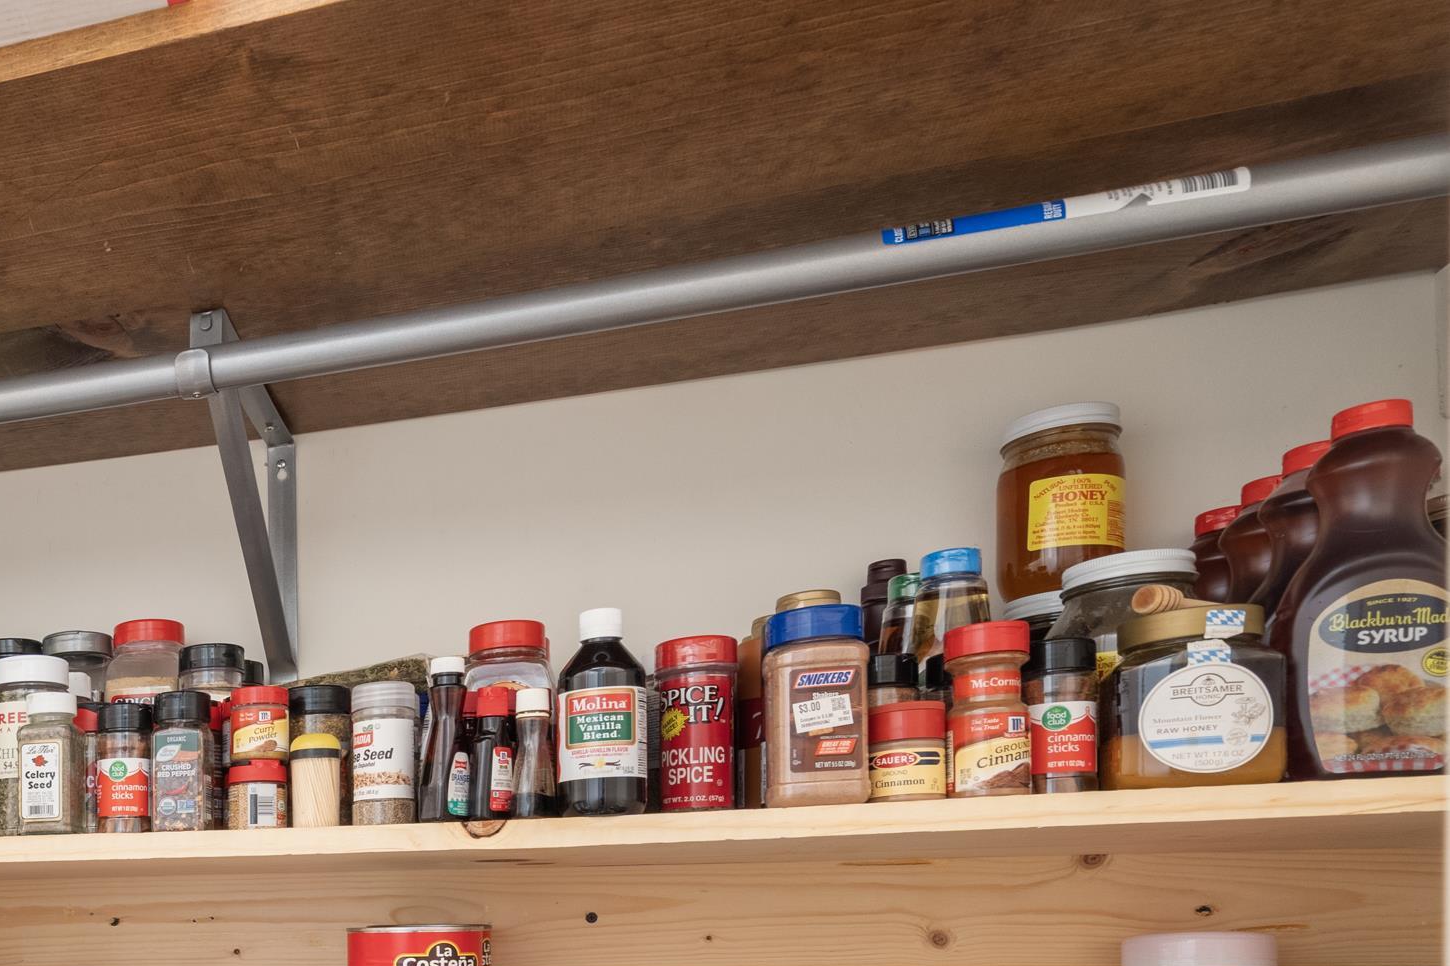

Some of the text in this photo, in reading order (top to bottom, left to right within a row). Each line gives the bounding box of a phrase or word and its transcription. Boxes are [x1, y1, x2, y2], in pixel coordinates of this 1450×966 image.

[1052, 490, 1107, 503] HONEY
[1328, 607, 1448, 632] Blackburn-Mad
[1357, 627, 1428, 645] SYRUP
[797, 671, 851, 687] SNICKERS
[1172, 684, 1243, 697] BREITSAMER
[571, 697, 627, 713] Molina
[660, 685, 718, 712] SPICE
[798, 701, 821, 713] $3.00
[576, 713, 624, 724] Mexican
[253, 724, 275, 737] Curry
[578, 722, 622, 732] Vanilla
[1156, 724, 1219, 735] RAW HONEY
[248, 731, 279, 744] Powder
[363, 747, 393, 761] Seed
[1047, 743, 1080, 754] sticks
[661, 747, 725, 766] PICKLING
[875, 754, 916, 767] SAUER'S
[161, 763, 192, 772] CRUSHED
[25, 770, 56, 783] Celery
[668, 766, 714, 786] SPICE
[874, 777, 926, 788] Cinnamon
[27, 779, 53, 790] Seed
[111, 783, 148, 792] cinnamon
[111, 791, 134, 800] sticks
[436, 946, 452, 957] La
